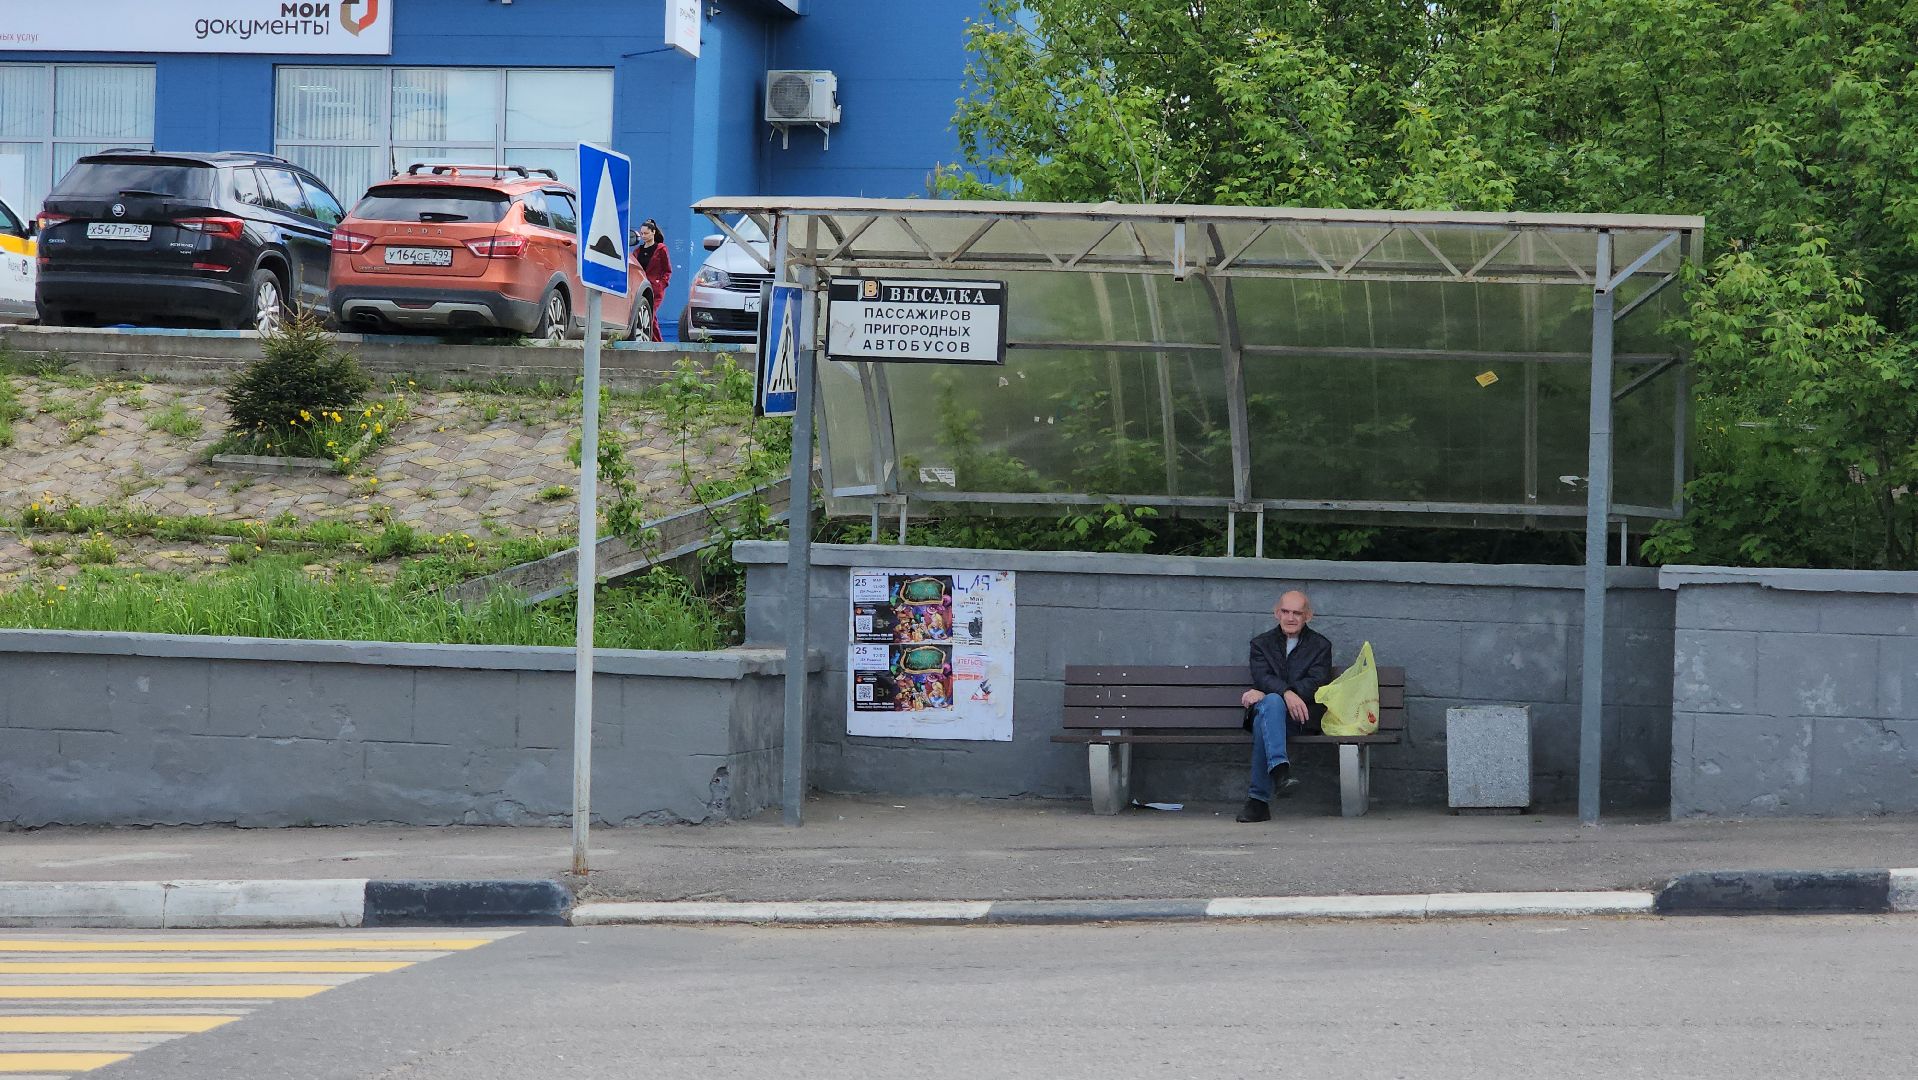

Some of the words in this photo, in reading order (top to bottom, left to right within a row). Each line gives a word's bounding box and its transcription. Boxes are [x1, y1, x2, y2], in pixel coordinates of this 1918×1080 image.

[195, 18, 329, 40] документы
[17, 33, 39, 43] услуг
[889, 287, 986, 304] ВЫСАДКА
[864, 307, 971, 321] ПАССАЖИРОВ
[864, 323, 971, 338] ПРИГОРОДНЫХ
[863, 339, 970, 353] АВТОБУСОВ
[855, 578, 867, 587] 25
[876, 619, 891, 629] 3+
[855, 646, 868, 655] 25
